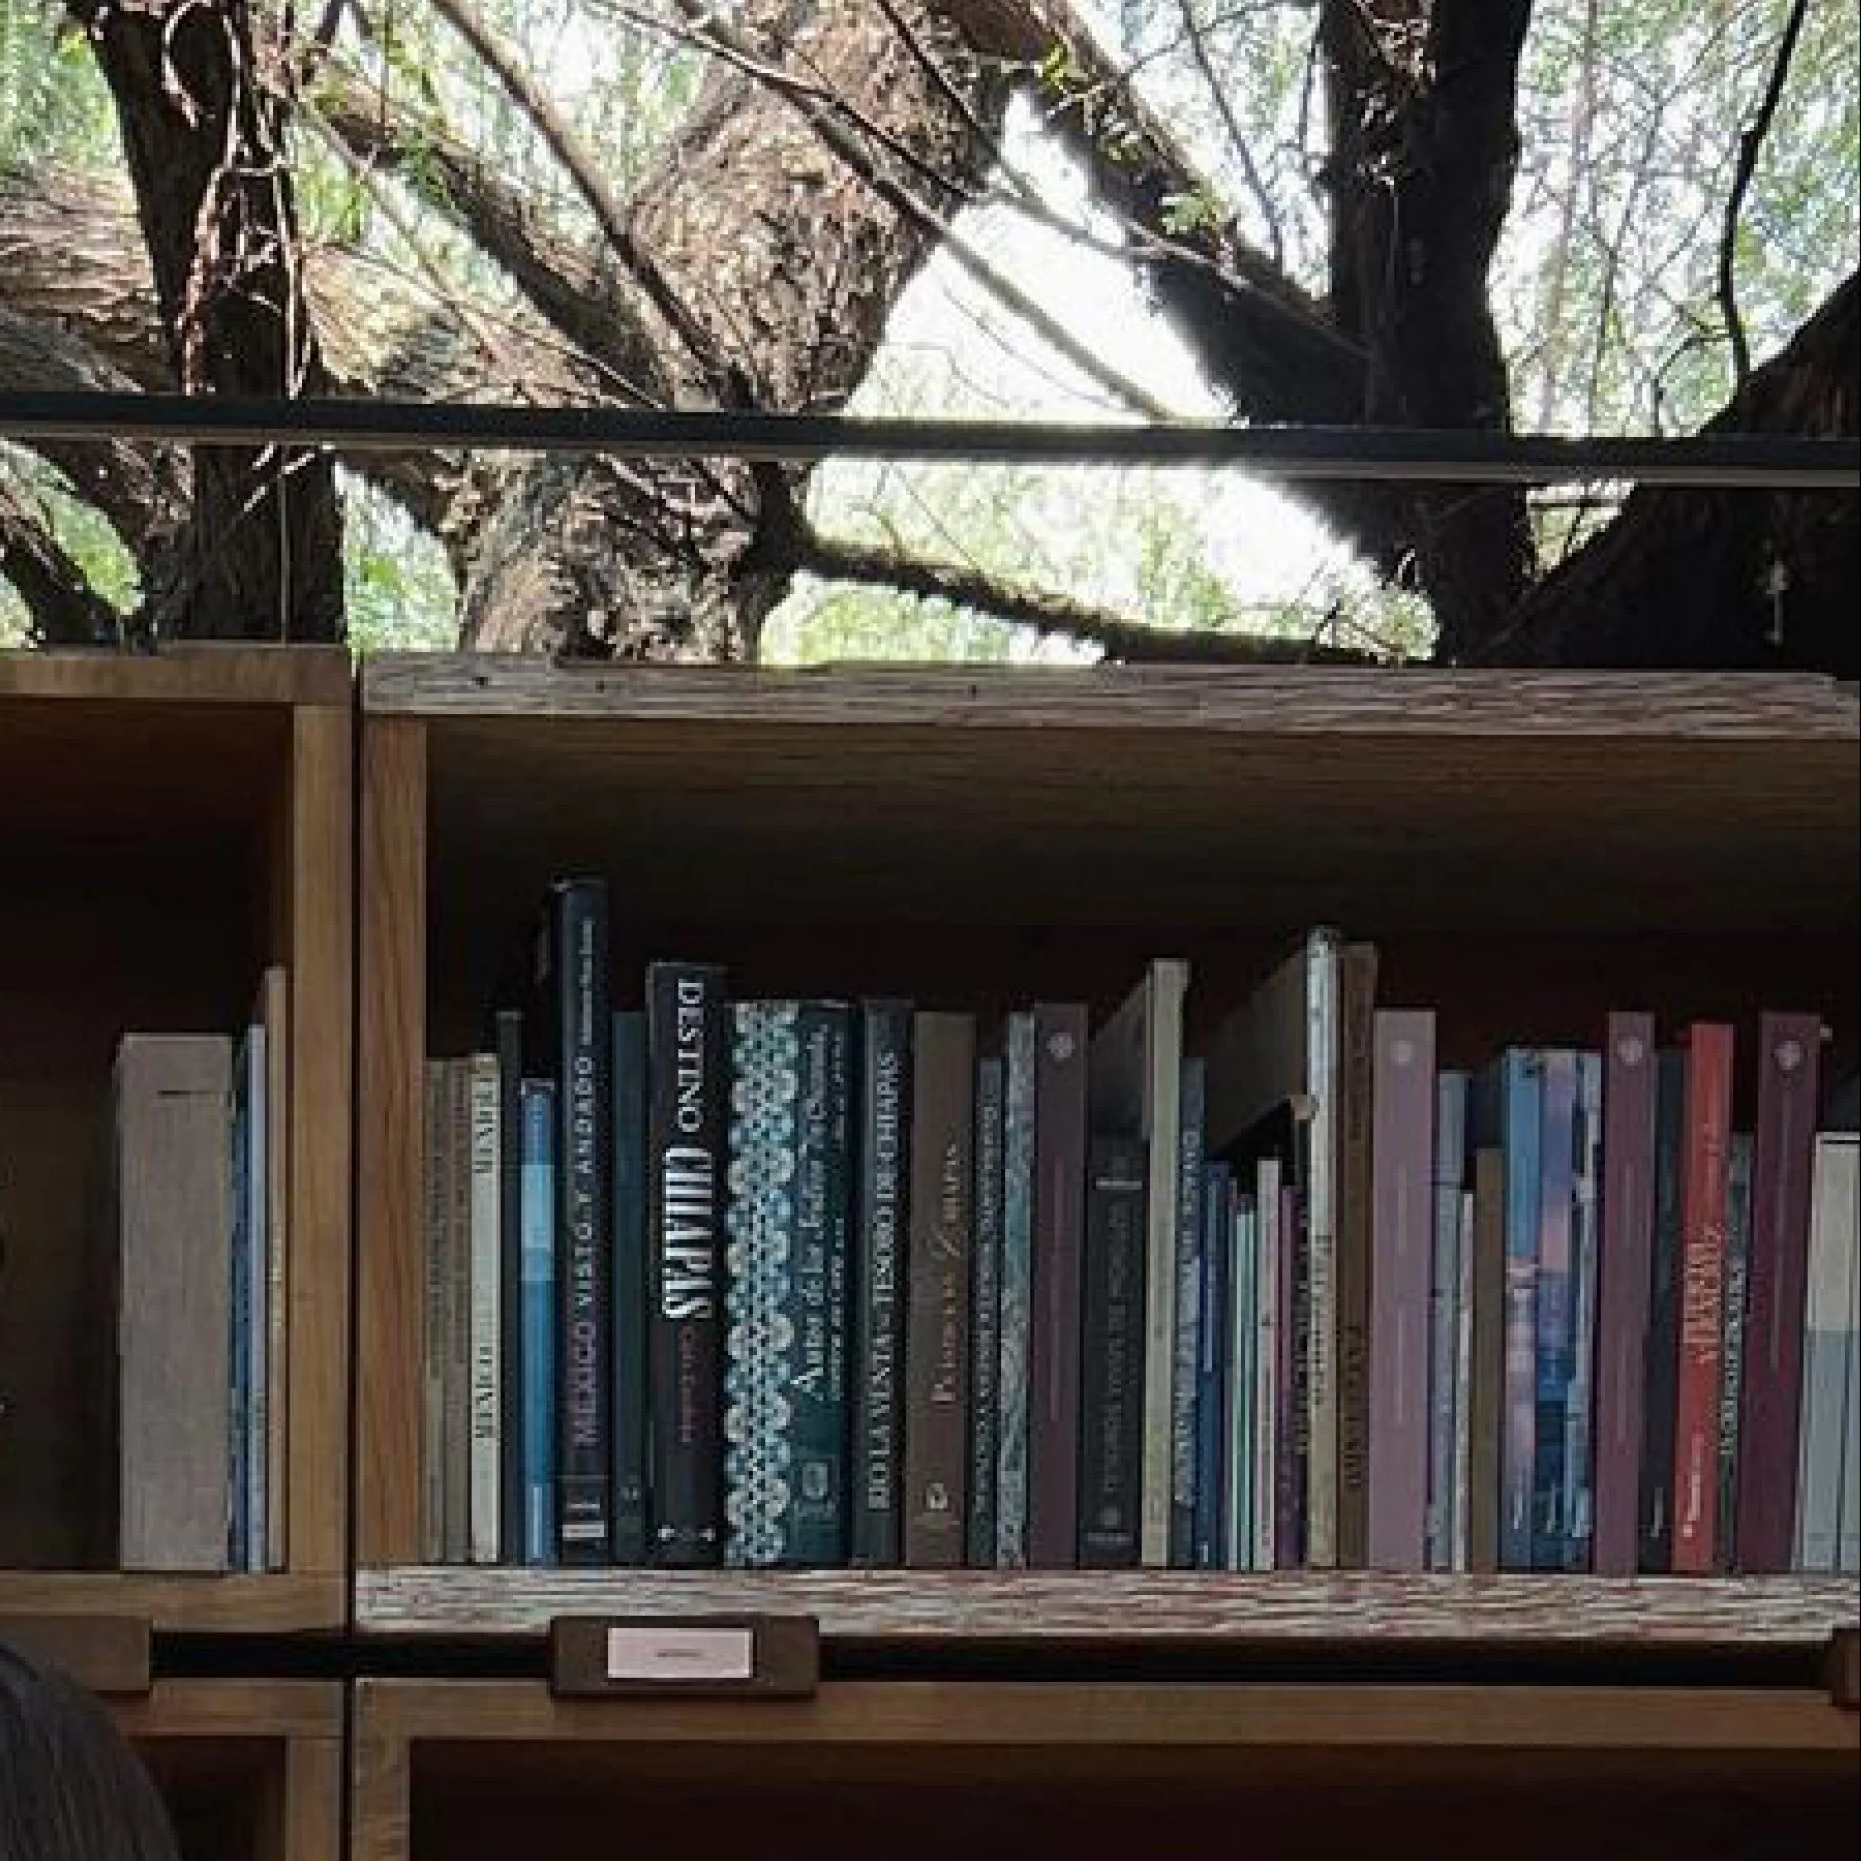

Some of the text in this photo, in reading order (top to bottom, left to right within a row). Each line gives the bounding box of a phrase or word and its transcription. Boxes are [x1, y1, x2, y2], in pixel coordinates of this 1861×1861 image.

[574, 1056, 593, 1175] ANDADO
[661, 977, 714, 1320] DESTINO CHIAPAS
[875, 1050, 900, 1160] CHIAPAS
[574, 1188, 593, 1205] Y
[575, 1222, 595, 1308] VISTO
[871, 1206, 896, 1306] TESORO
[870, 1333, 893, 1419] VENTA
